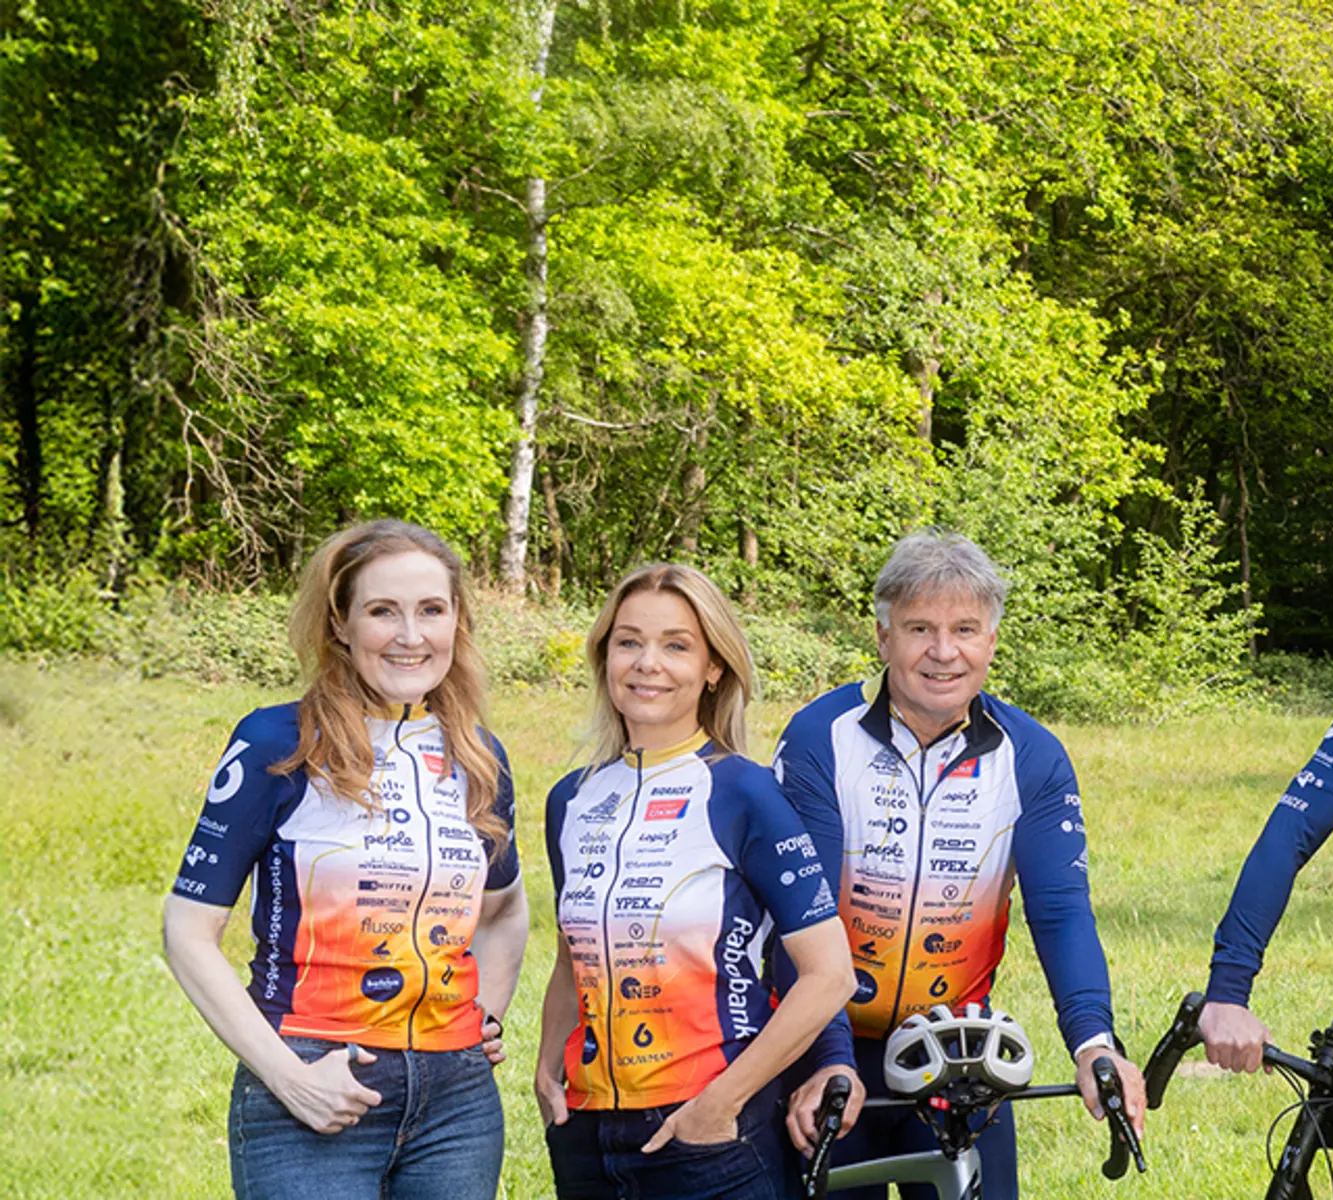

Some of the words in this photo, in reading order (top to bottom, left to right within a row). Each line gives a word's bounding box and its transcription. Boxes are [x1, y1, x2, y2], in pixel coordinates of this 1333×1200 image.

[206, 739, 251, 804] 6
[887, 817, 908, 835] 10
[583, 862, 605, 878] 10
[929, 859, 980, 874] YPEX.nl
[722, 915, 759, 1041] Rabobank
[928, 974, 948, 998] 6
[632, 1022, 654, 1048] 6
